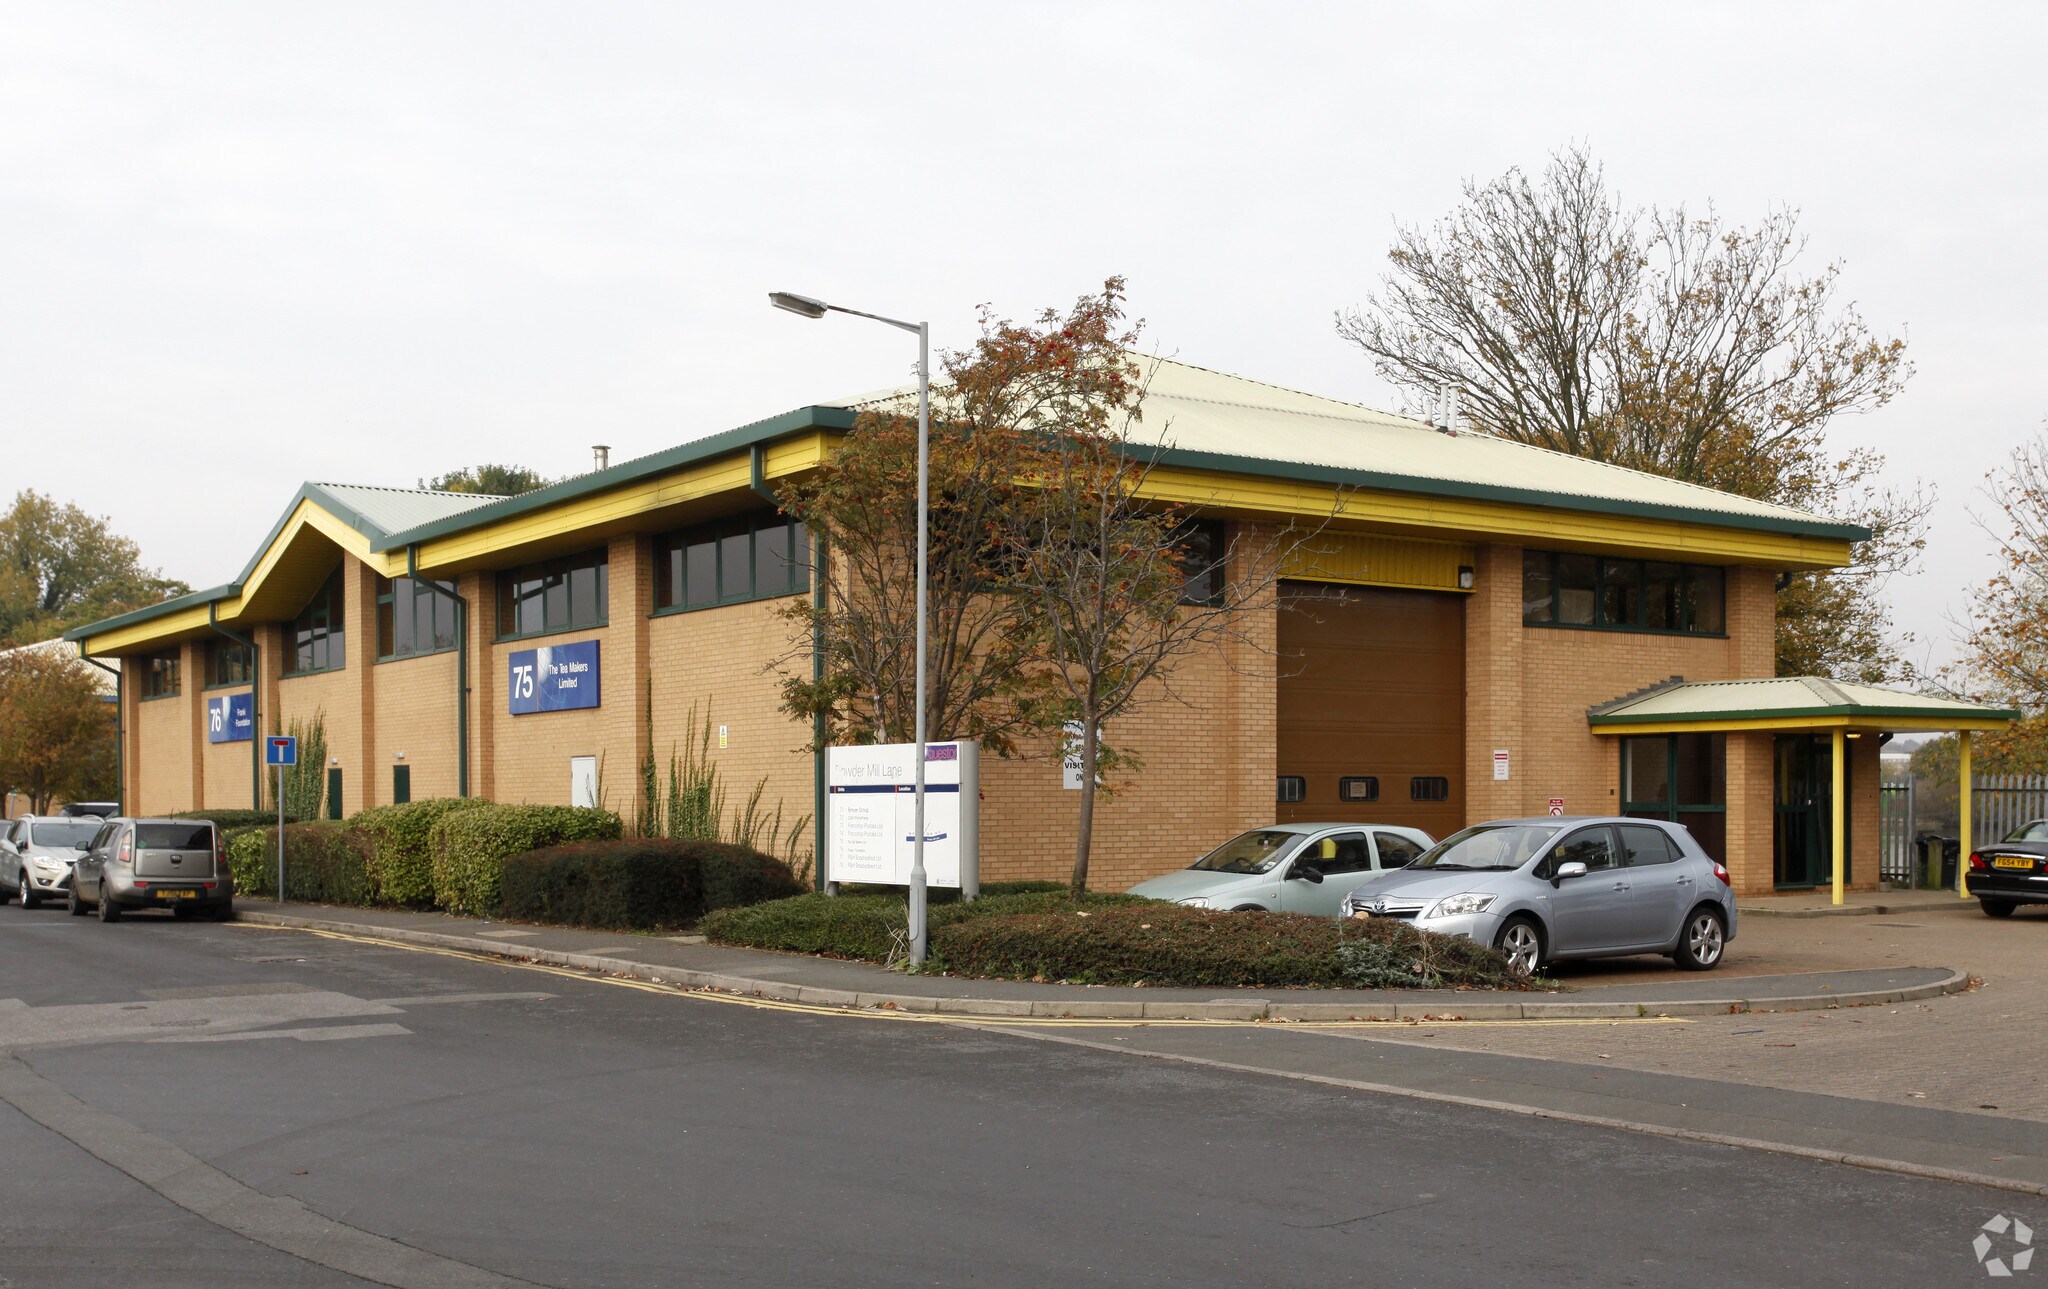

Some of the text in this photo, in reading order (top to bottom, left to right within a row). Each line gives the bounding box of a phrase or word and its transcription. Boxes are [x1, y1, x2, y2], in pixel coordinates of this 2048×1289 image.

[549, 661, 589, 675] The Tea Makers
[513, 665, 533, 699] 75
[558, 677, 578, 689] Limited
[210, 708, 221, 732] 76
[867, 763, 881, 777] Mill
[882, 763, 903, 777] Lane
[1997, 858, 2030, 867] FG54 YBY
